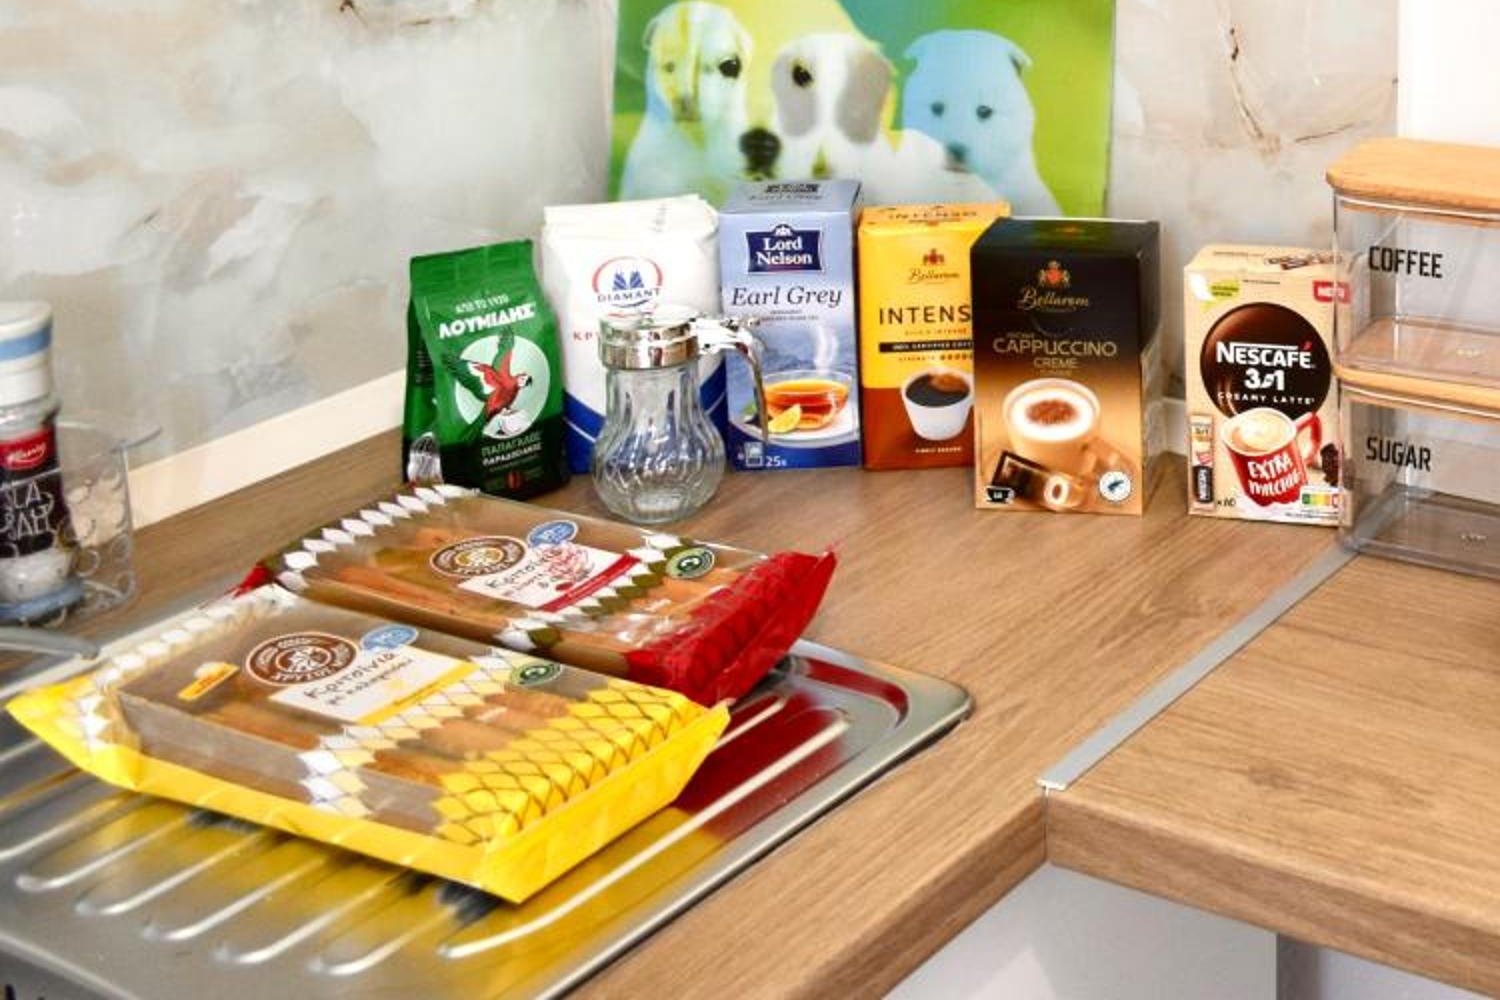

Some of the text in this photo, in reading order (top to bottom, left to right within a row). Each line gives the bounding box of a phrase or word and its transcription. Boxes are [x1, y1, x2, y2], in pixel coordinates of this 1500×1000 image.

[763, 236, 803, 251] Lord
[756, 251, 813, 265] Nelson
[1368, 246, 1444, 279] COFFEE
[598, 287, 661, 303] DIAMANT
[732, 285, 842, 308] Earl Grey
[439, 302, 537, 340] ΛΟΥΜΙΔΗΣ
[879, 304, 971, 325] INTENS
[992, 337, 1118, 357] CAPPUCCINO
[1216, 341, 1313, 369] NESCAFÉ
[1366, 435, 1432, 472] SUGAR
[1247, 450, 1294, 481] EXTRA
